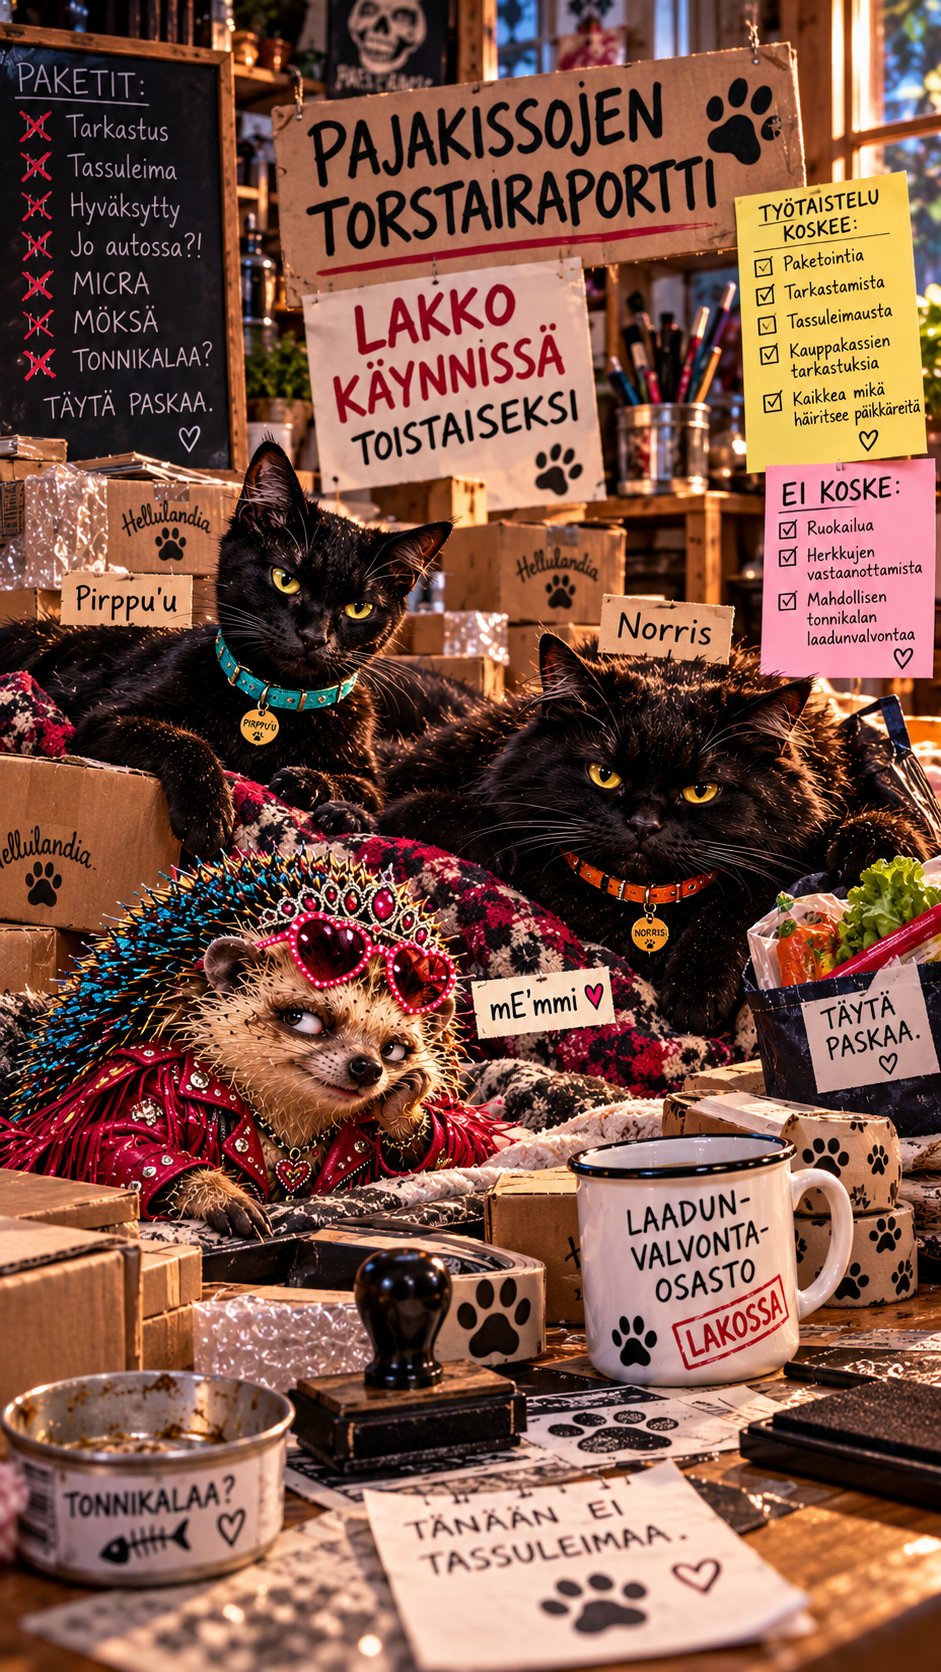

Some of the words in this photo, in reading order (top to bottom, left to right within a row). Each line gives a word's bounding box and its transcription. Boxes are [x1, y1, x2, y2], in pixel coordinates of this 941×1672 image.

[16, 62, 145, 98] PAKETIT:
[66, 114, 168, 141] Tarkastus
[307, 82, 663, 187] PAJAKISSOJEN
[67, 153, 177, 180] Tassuleima
[71, 192, 180, 228] Hyväksytty
[306, 156, 717, 256] TORSTAIRAPORTTI
[758, 189, 879, 222] TYÖTAISTELU
[783, 216, 858, 242] KOSKEE:
[71, 231, 93, 256] Jo
[106, 233, 201, 258] autossa?!
[783, 248, 864, 271] Paketointia
[74, 271, 149, 295] MICRA
[784, 275, 885, 299] Tarkastamista
[74, 305, 158, 333] MÖKSÄ
[354, 284, 516, 355] LAKKO
[787, 303, 892, 328] Tassuleimausta
[73, 341, 212, 371] TONNIKALAA?
[789, 335, 890, 361] Kauppakassien
[333, 323, 565, 424] KÄYNNISSÄ
[791, 356, 880, 378] tarkastuksia
[44, 390, 115, 419] TÄYTÄ
[129, 392, 212, 415] PASKAA.
[793, 388, 846, 407] Kaikkea
[854, 382, 885, 398] mikä
[351, 390, 579, 465] TOISTAISEKSI
[794, 409, 849, 426] häiritsee
[854, 399, 921, 425] päikkäreitä
[783, 482, 804, 506] EI
[821, 476, 900, 504] KOSKE:
[808, 518, 874, 535] Ruokailua
[807, 545, 875, 564] Herkkujen
[807, 560, 923, 581] vastaanottamista
[76, 585, 177, 621] Pirppu'u
[808, 590, 886, 606] Mahdollisen
[618, 612, 711, 645] Norris
[807, 609, 876, 626] tonnikalan
[808, 628, 915, 646] laadunvalvontaa
[635, 929, 665, 937] NORRIS
[491, 988, 577, 1021] mE'mmi
[820, 990, 896, 1029] TÄYTÄ
[826, 1020, 921, 1060] PASKAA.
[627, 1190, 751, 1236] LAADUN-
[630, 1220, 769, 1271] VALVONTA-
[656, 1258, 755, 1303] OSASTO
[685, 1290, 783, 1358] LAKOSSA
[63, 1474, 236, 1519] TONNIKALAA?
[404, 1504, 559, 1540] TÄNÄÄN
[588, 1500, 623, 1519] EI
[419, 1524, 688, 1576] TASSULEIMAA.
